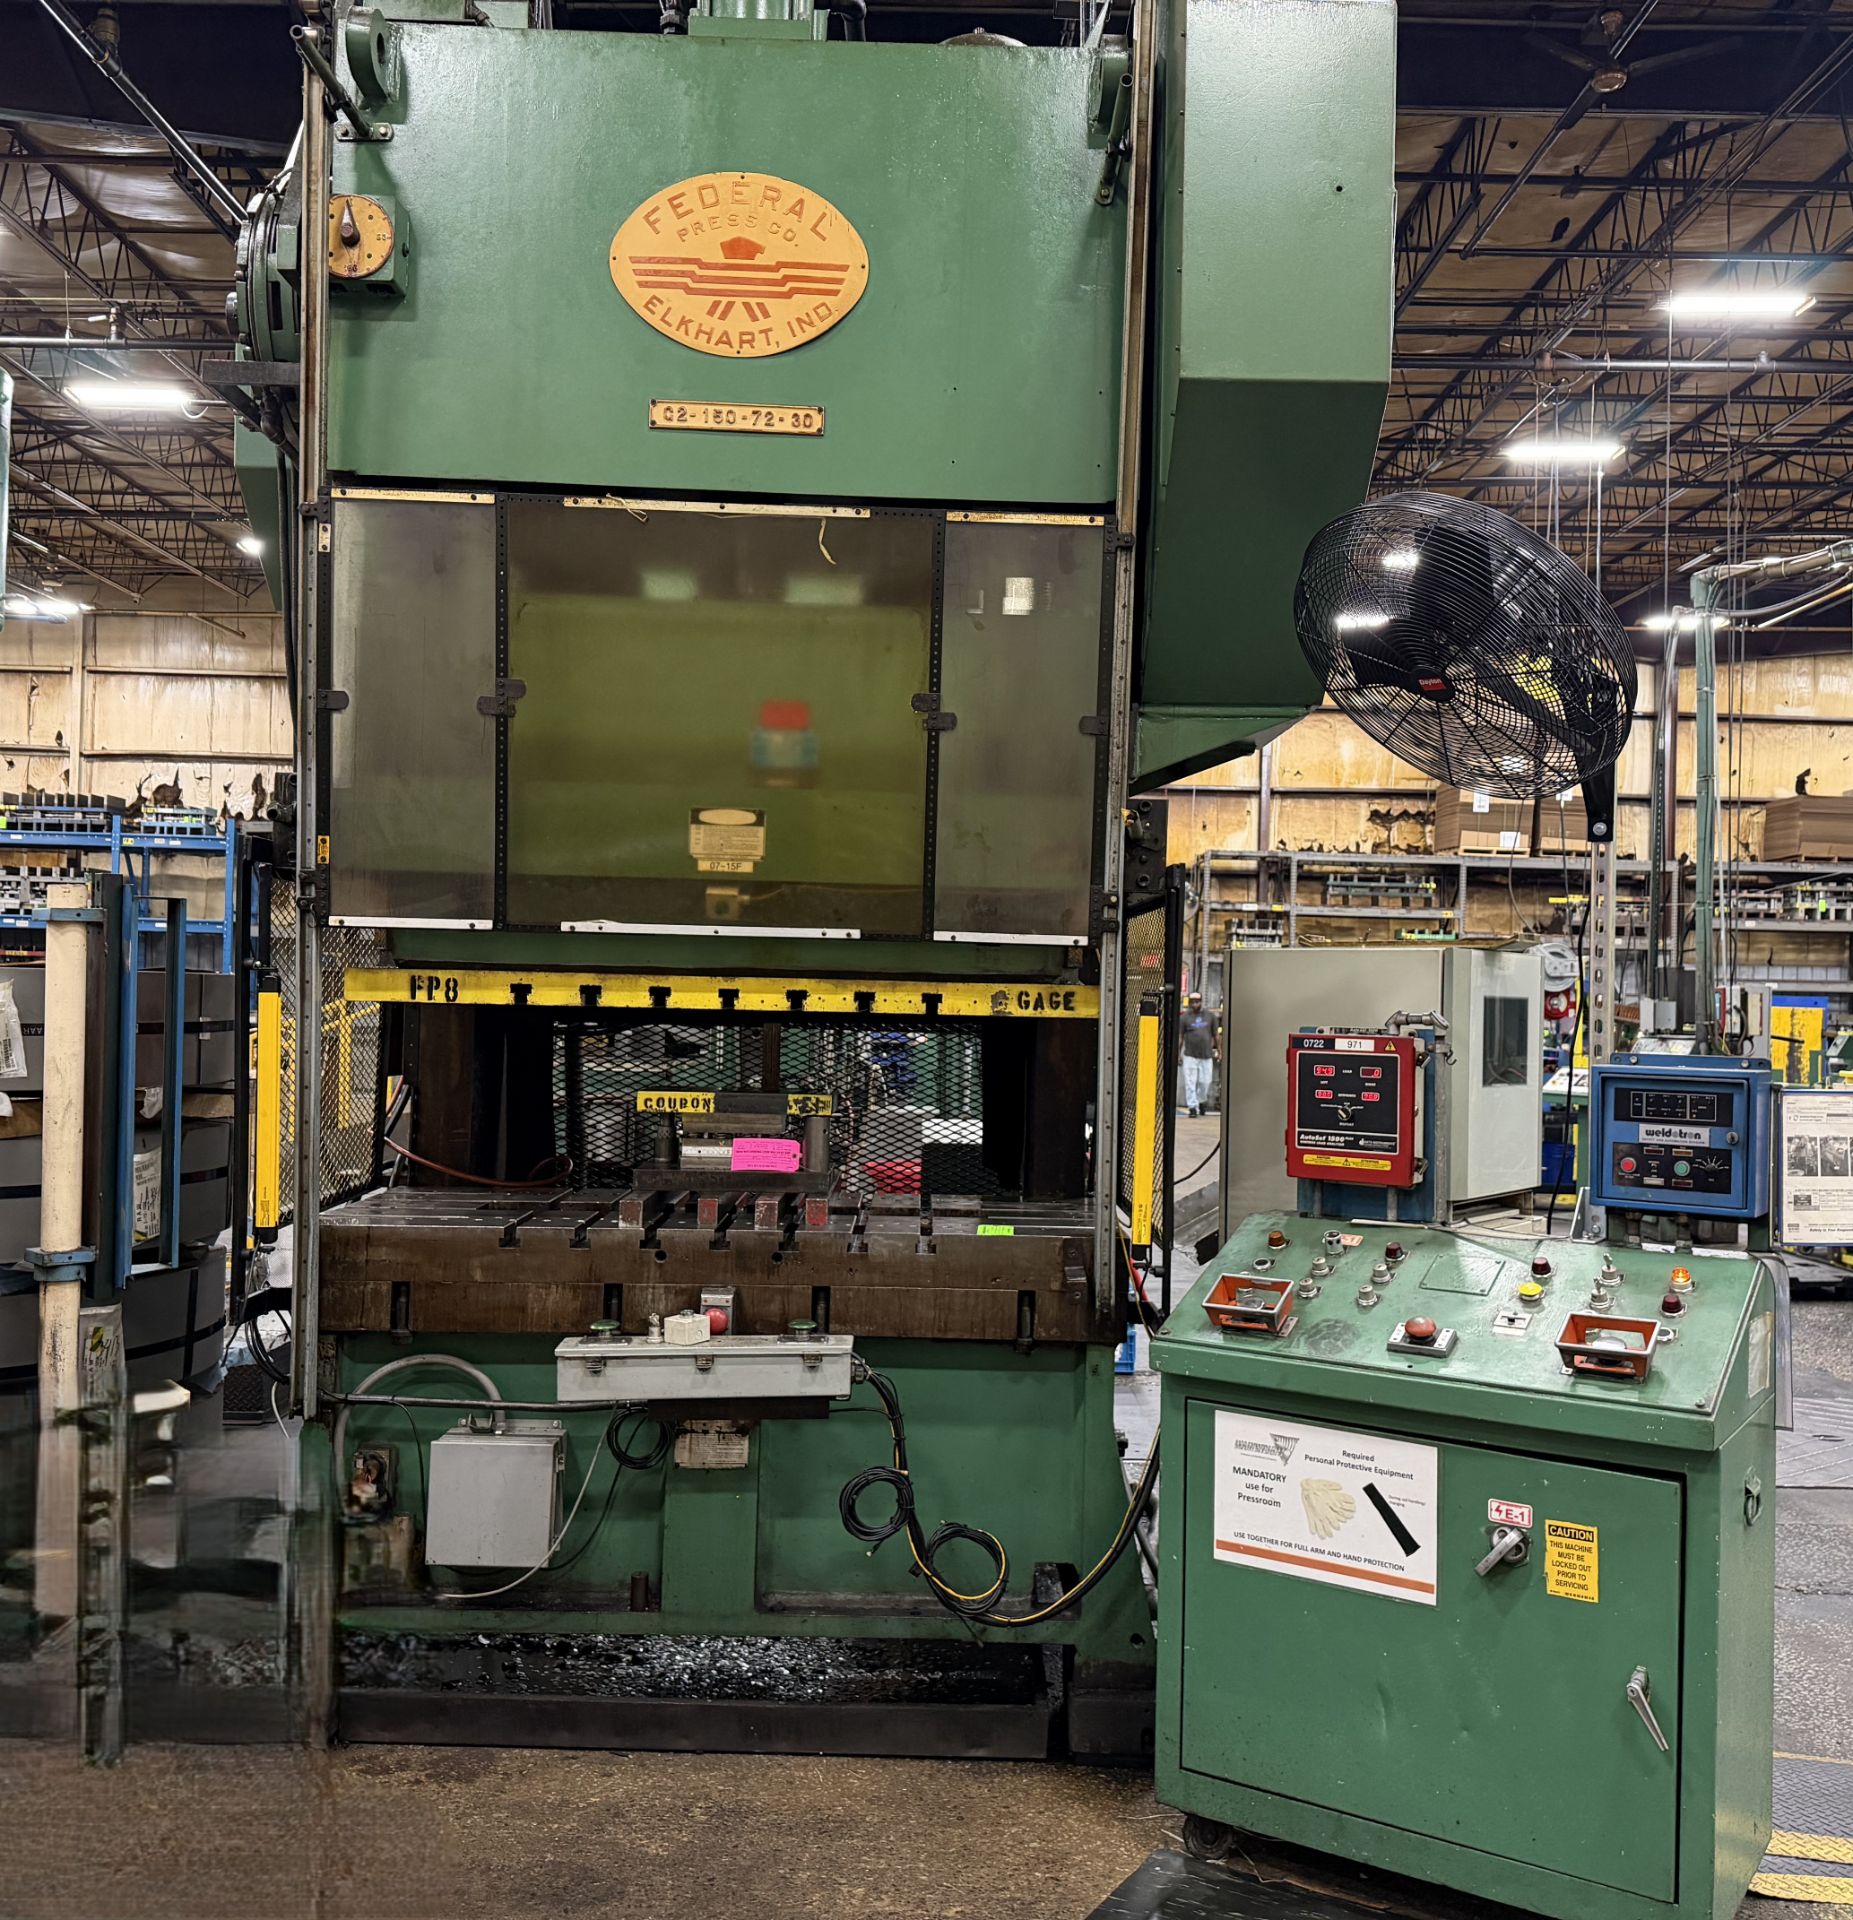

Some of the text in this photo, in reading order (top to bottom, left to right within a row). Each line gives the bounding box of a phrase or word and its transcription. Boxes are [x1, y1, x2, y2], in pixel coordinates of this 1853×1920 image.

[643, 181, 828, 242] FEDERAL
[677, 213, 798, 247] PRESS CO.
[643, 295, 839, 348] ELKHART, IND.
[709, 862, 742, 871] 07-15F
[1017, 991, 1076, 1012] GAGE
[1304, 1039, 1324, 1048] 0722
[1347, 1040, 1362, 1049] 971
[644, 1097, 711, 1112] COUPON
[1645, 1128, 1701, 1140] weldotron
[1342, 1450, 1375, 1463] Required
[1304, 1454, 1414, 1481] Personal Protective Equipment
[1232, 1465, 1287, 1484] MANDATORY
[1245, 1482, 1274, 1494] use for
[1237, 1492, 1281, 1508] Pressroom
[1505, 1508, 1525, 1522] E-1
[1549, 1526, 1593, 1541] CAUTION
[1233, 1531, 1405, 1572] USE TOGETHER FOR FULL ARM AND HAND PROTECTION
[1550, 1541, 1593, 1553] THIS MACHINE
[1557, 1551, 1585, 1562] MUST BE
[1551, 1560, 1592, 1573] LOCKED OUT
[1557, 1570, 1586, 1581] PRIOR TO
[1555, 1579, 1589, 1591] SERVICING
